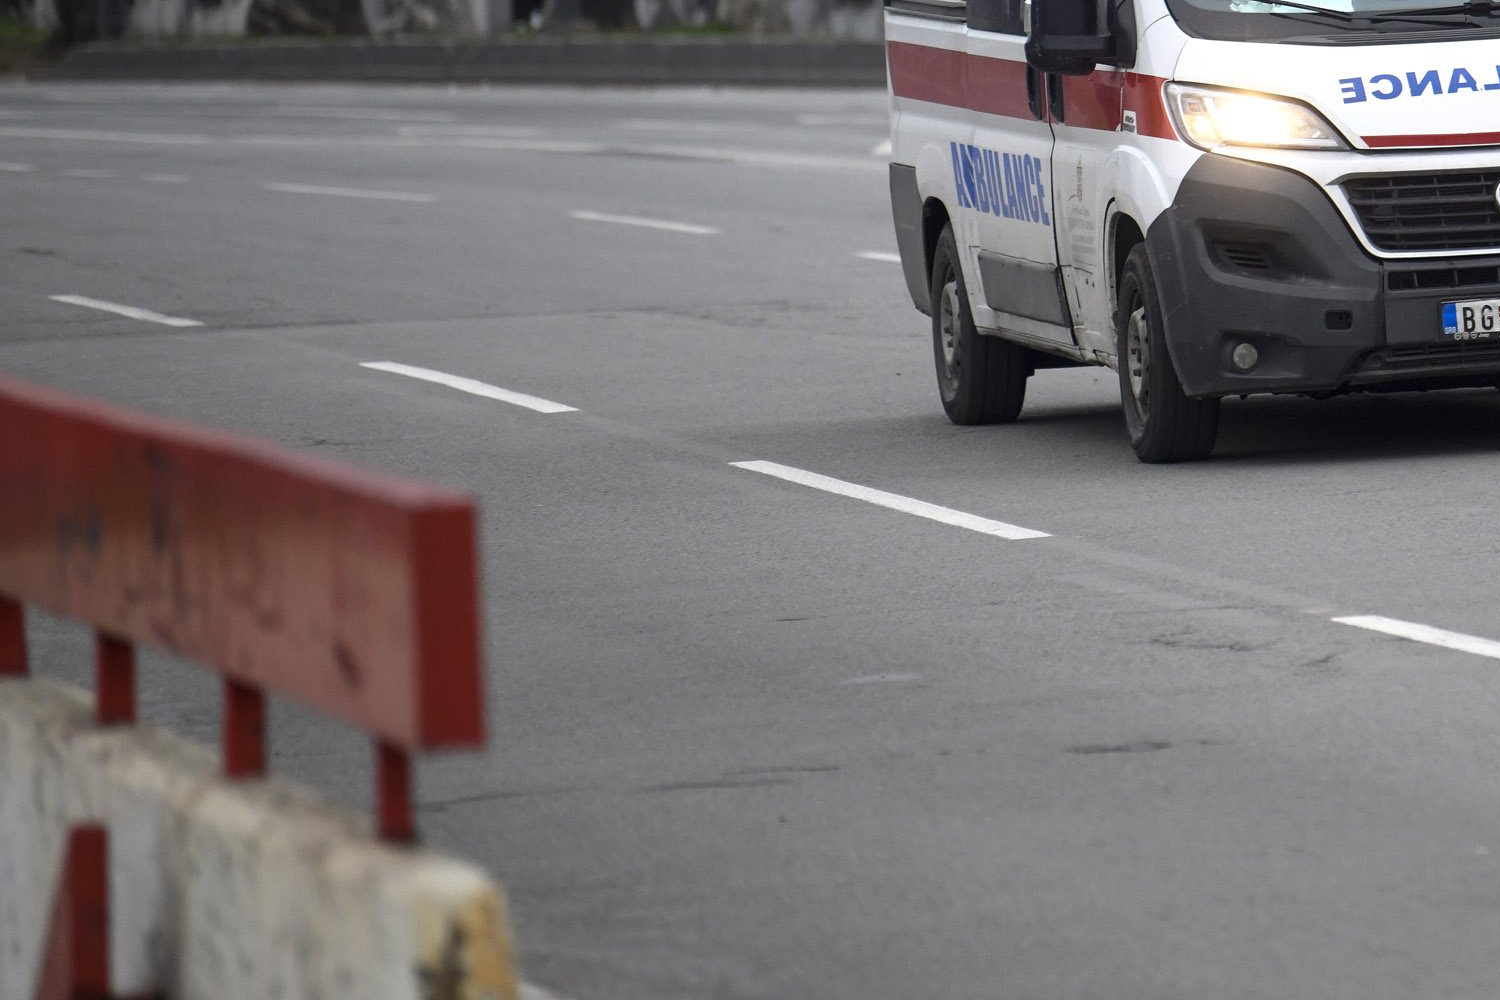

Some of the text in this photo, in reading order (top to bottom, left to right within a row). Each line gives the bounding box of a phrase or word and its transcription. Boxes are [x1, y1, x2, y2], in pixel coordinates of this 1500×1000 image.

[950, 141, 1050, 226] AMBULANCE
[1444, 326, 1457, 335] SRB
[1462, 304, 1494, 333] BG
